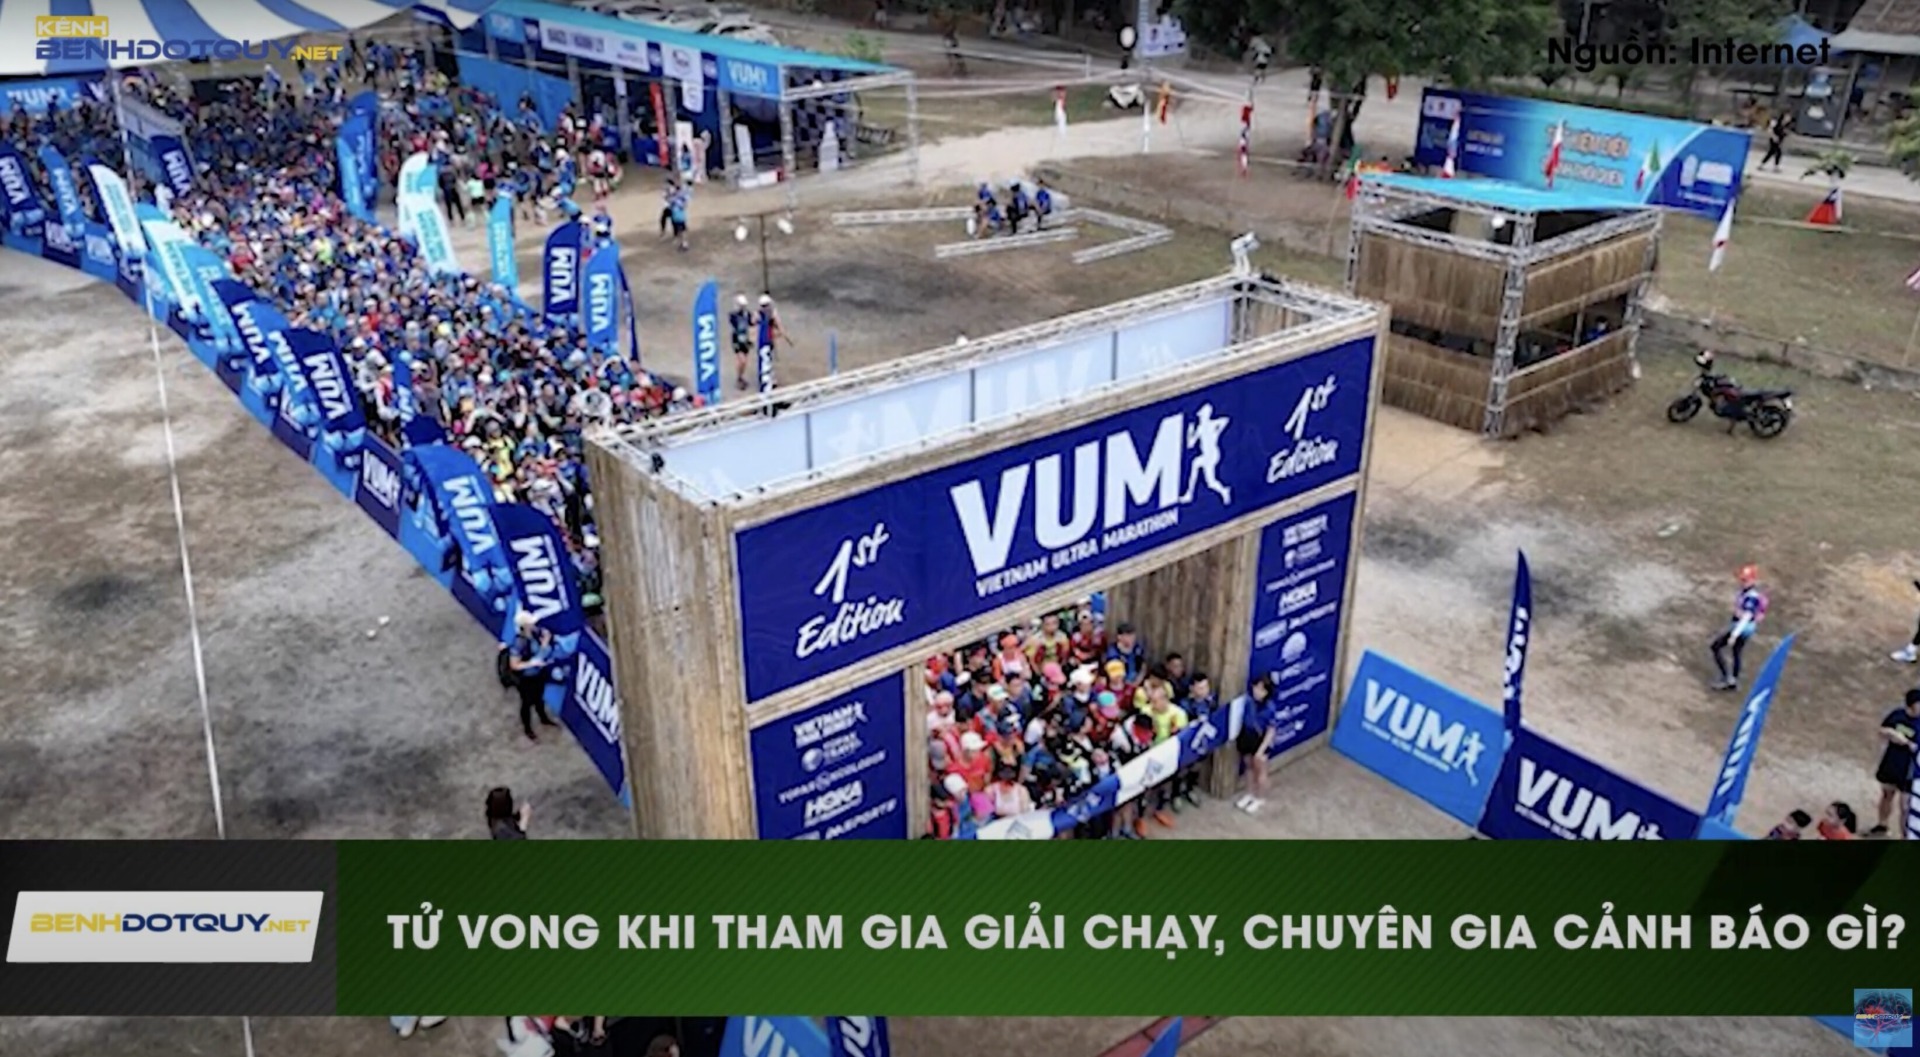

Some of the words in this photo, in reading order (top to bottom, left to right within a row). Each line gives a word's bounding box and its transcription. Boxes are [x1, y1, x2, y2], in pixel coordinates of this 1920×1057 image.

[550, 247, 574, 303] VUM
[590, 274, 615, 332] VUM
[231, 300, 271, 364] VUM
[698, 314, 716, 382] VUM
[304, 352, 349, 420] VUM
[1284, 374, 1337, 441] 1st
[1266, 435, 1338, 483] Edition
[443, 475, 496, 554] VUM
[950, 412, 1184, 577] VUM
[510, 535, 563, 625] VUM
[813, 522, 890, 604] 1st
[976, 556, 1049, 598] VIETNAM
[1051, 537, 1099, 569] ULTRA
[1101, 508, 1180, 550] MARATHON
[796, 596, 905, 659] Edition
[575, 652, 621, 734] VUM
[1364, 677, 1466, 763] VUM
[804, 780, 862, 818] HOKA
[1517, 756, 1642, 840] VUM
